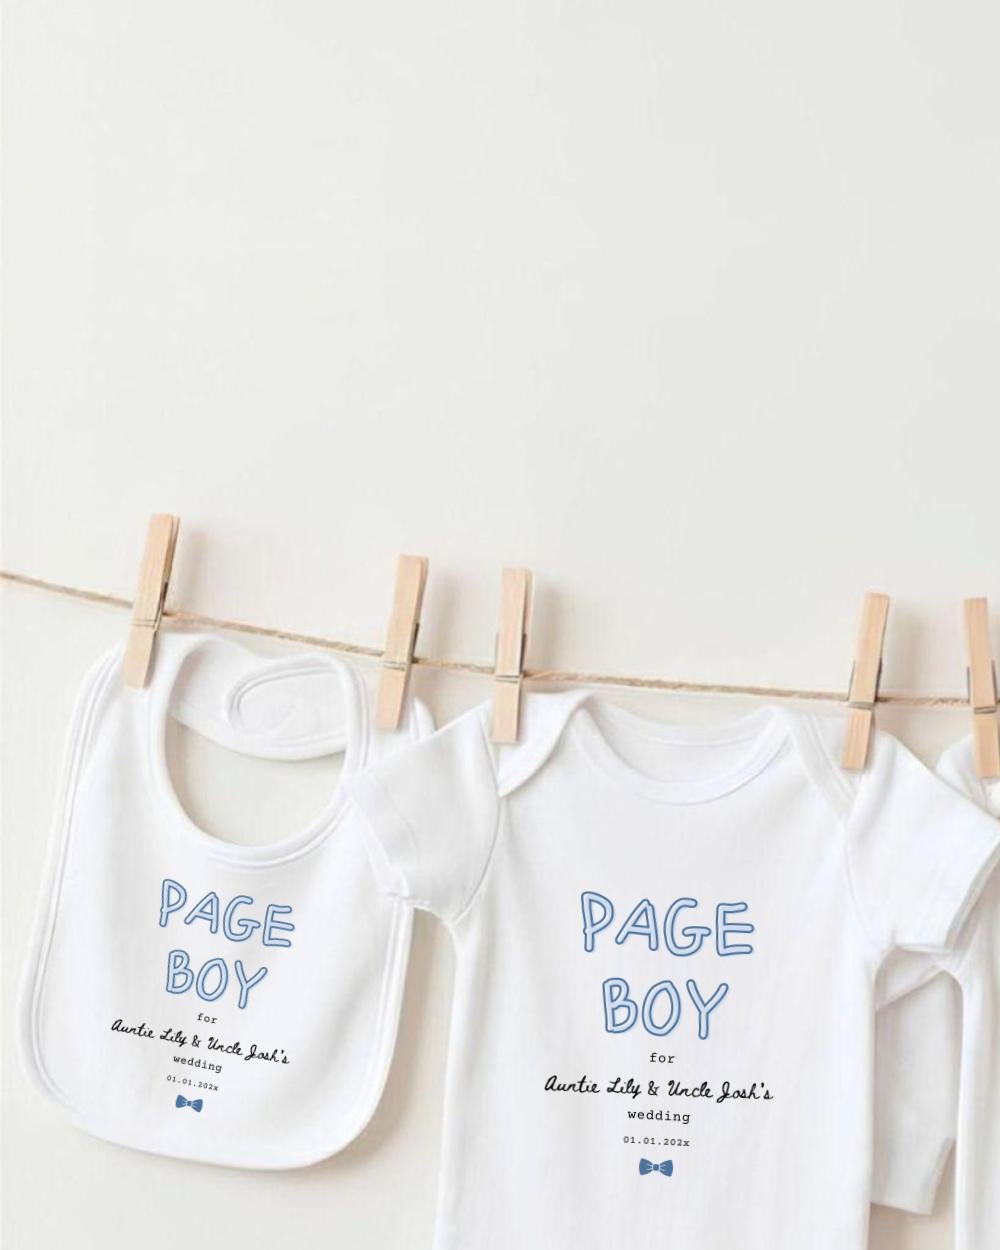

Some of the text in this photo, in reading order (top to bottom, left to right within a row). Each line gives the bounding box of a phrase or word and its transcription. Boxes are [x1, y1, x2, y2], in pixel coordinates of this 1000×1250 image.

[158, 878, 296, 948] PAGE
[580, 890, 755, 958] PAGE
[165, 949, 268, 1010] BOY
[197, 1012, 218, 1024] for
[601, 977, 730, 1041] BOY
[110, 1018, 290, 1065] Auntie Lily & Uncle Josh's
[173, 1055, 223, 1074] wedding
[649, 1052, 675, 1064] for
[543, 1074, 774, 1104] Auntie Lily & Uncle Josh's
[627, 1109, 691, 1125] wedding
[623, 1135, 690, 1147] 01.01.202x
